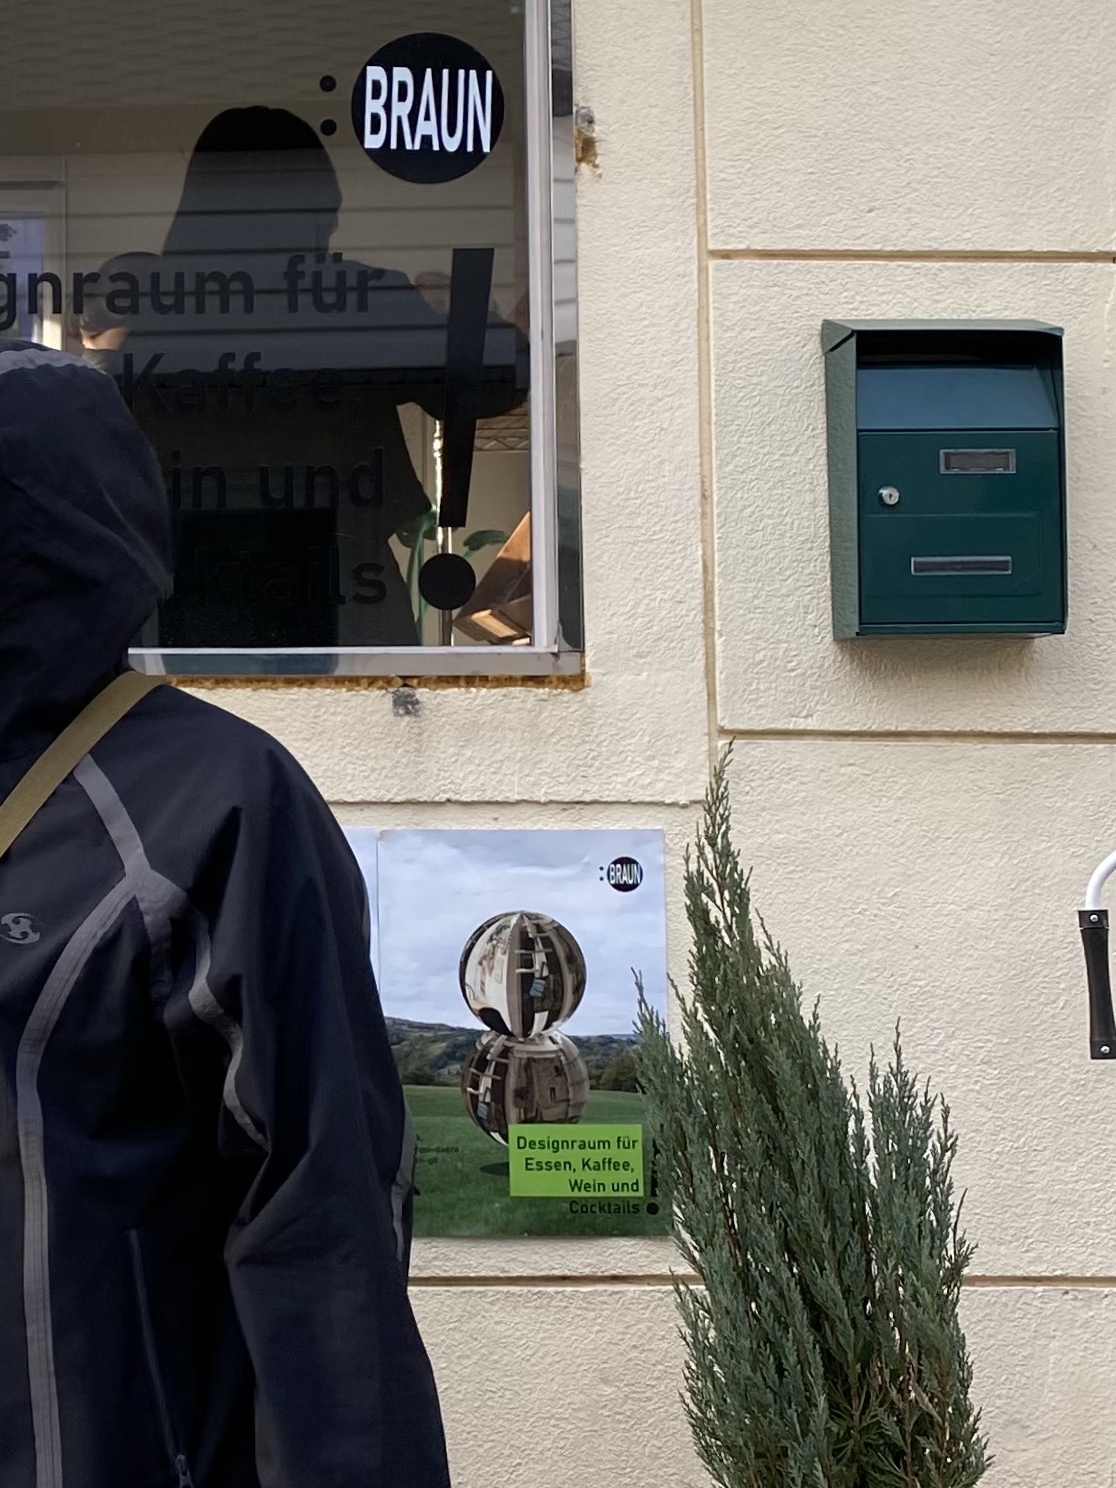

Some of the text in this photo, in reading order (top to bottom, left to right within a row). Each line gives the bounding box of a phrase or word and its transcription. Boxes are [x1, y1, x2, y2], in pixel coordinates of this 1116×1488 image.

[364, 65, 493, 153] BRAUN
[283, 252, 384, 315] für
[259, 448, 384, 509] und
[609, 863, 641, 885] BRAUN
[516, 1135, 639, 1153] Designraum für
[524, 1157, 635, 1173] Essen, Kaffee,
[568, 1178, 640, 1193] Wein und
[569, 1200, 641, 1215] Cocktails
